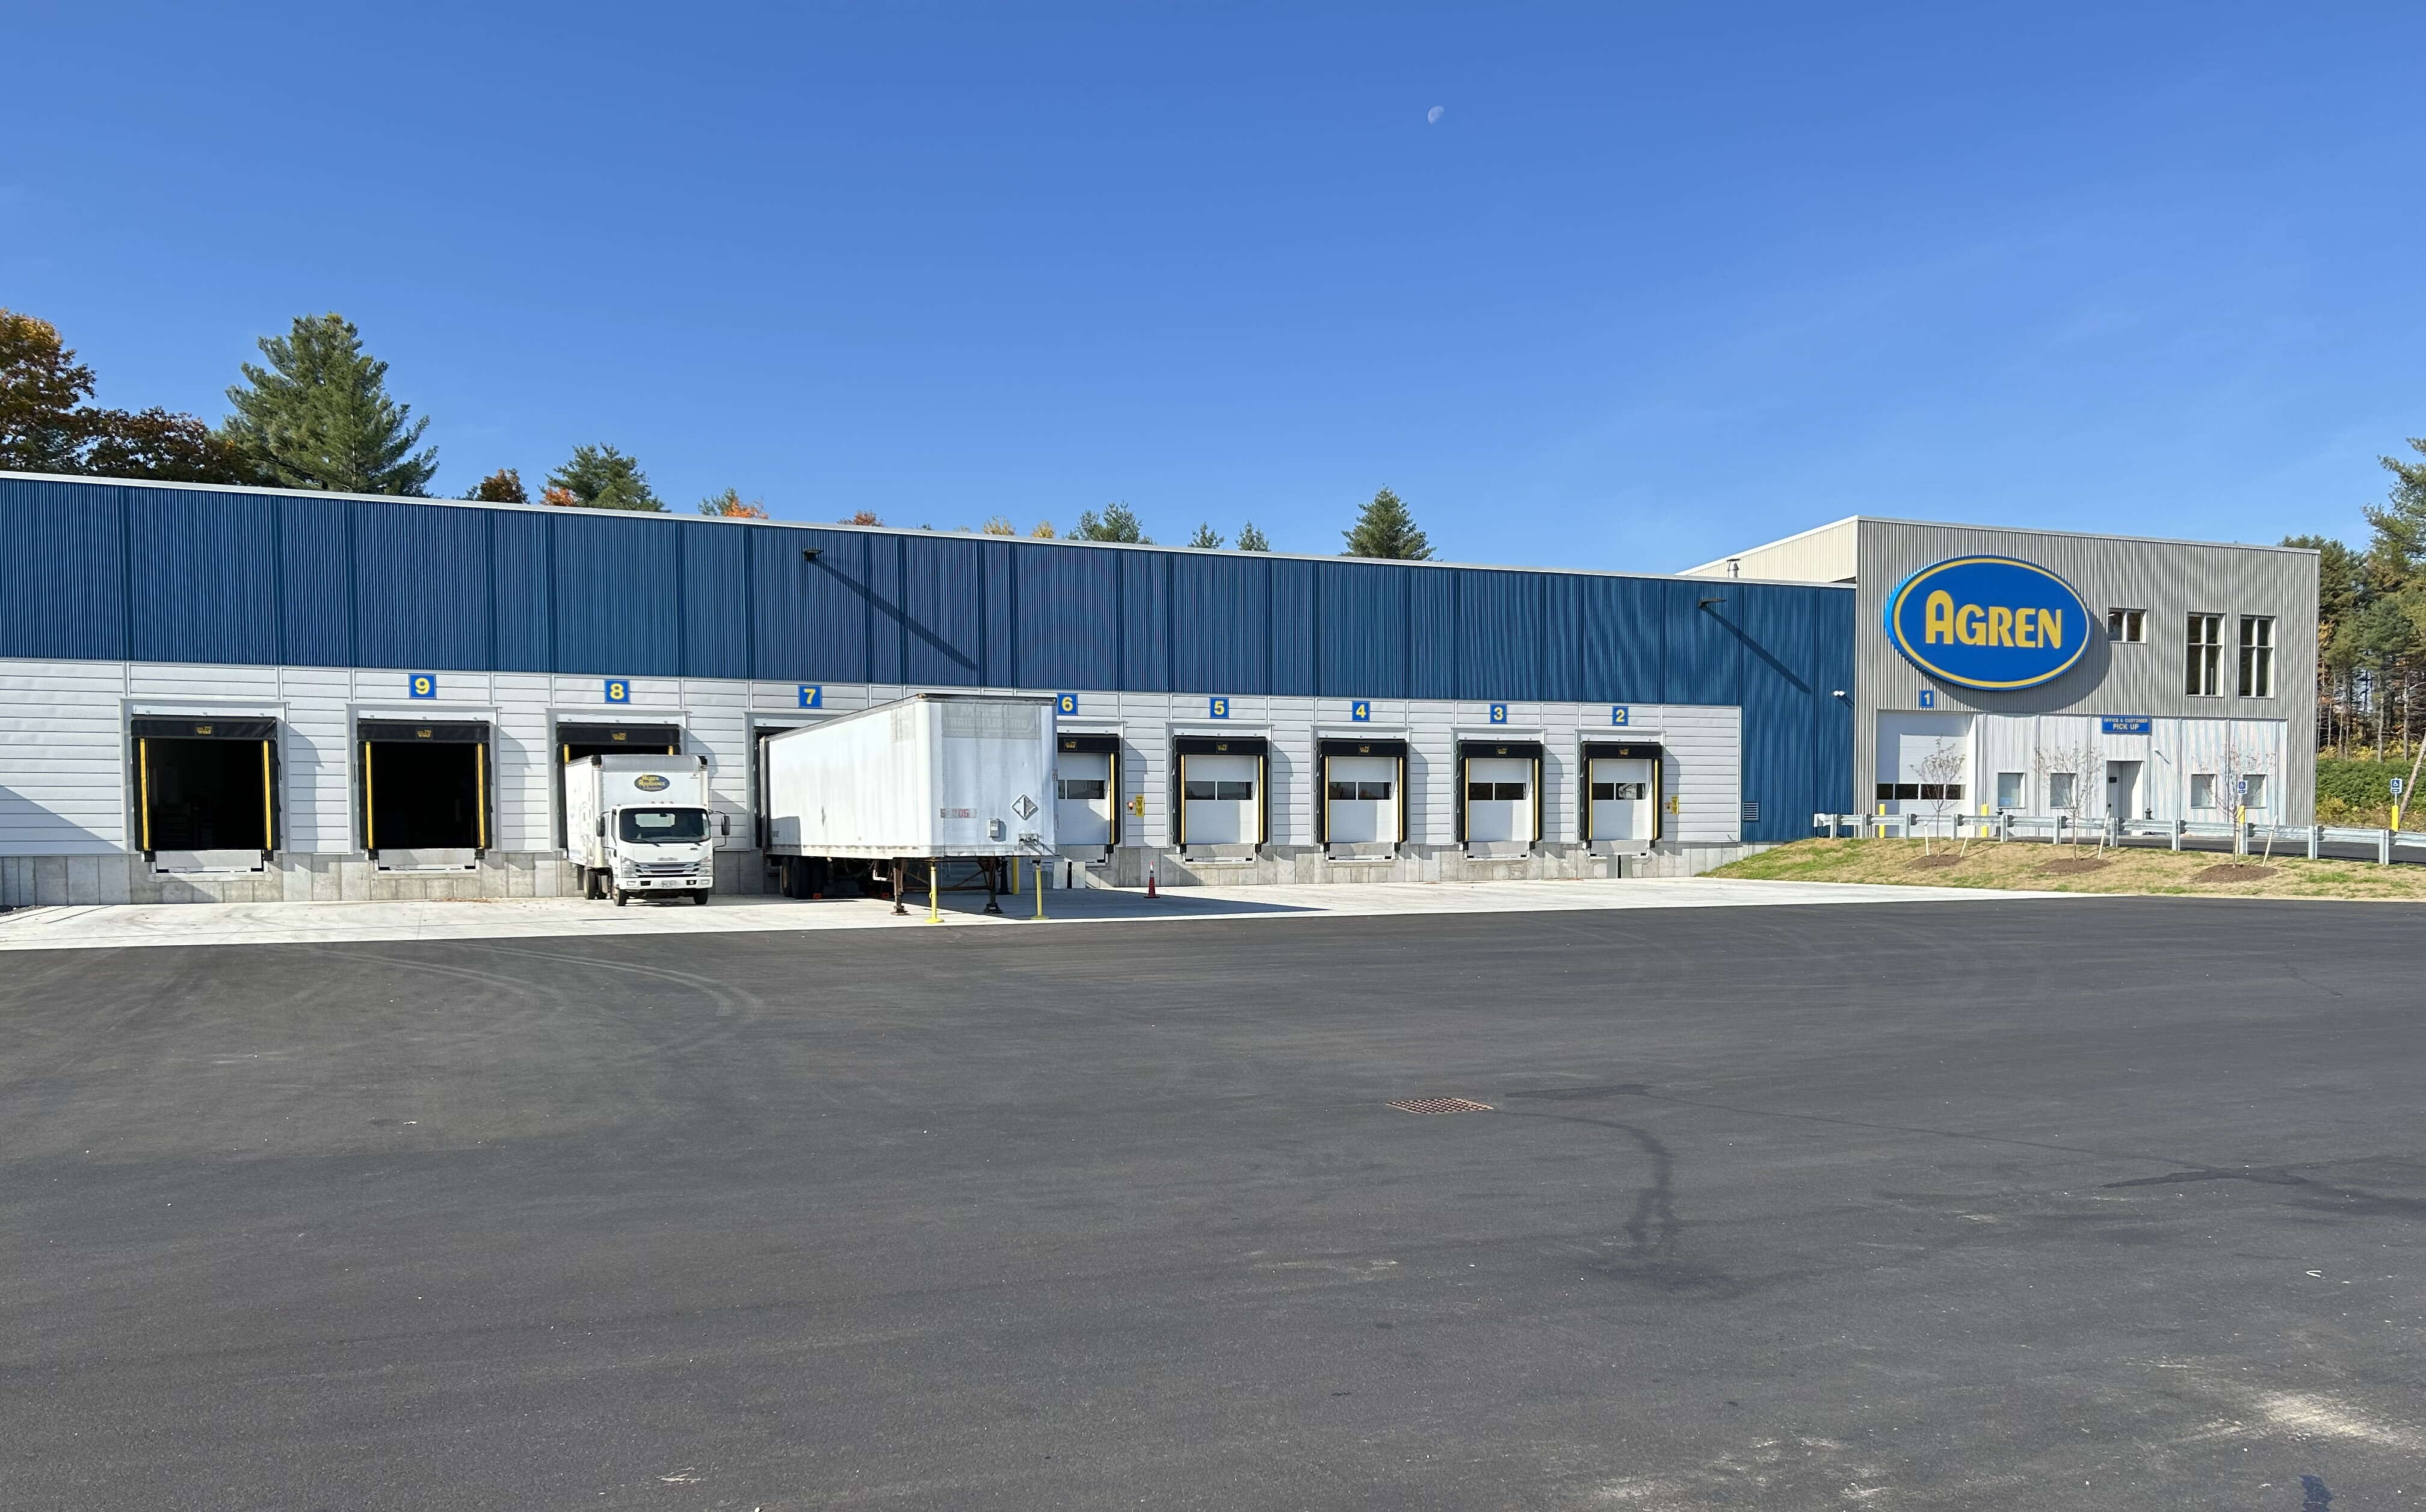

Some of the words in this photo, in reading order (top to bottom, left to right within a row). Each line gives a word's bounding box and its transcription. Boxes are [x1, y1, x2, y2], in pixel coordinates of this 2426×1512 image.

[1925, 590, 2062, 649] AGREN
[415, 677, 430, 695] 9
[610, 683, 625, 700] 8
[804, 688, 816, 705] 7
[1061, 696, 1073, 712] 6
[1924, 693, 1930, 705] 1
[1214, 700, 1225, 715] 5
[1356, 704, 1366, 718] 4
[1493, 706, 1504, 721] 3
[1616, 709, 1625, 723] 2
